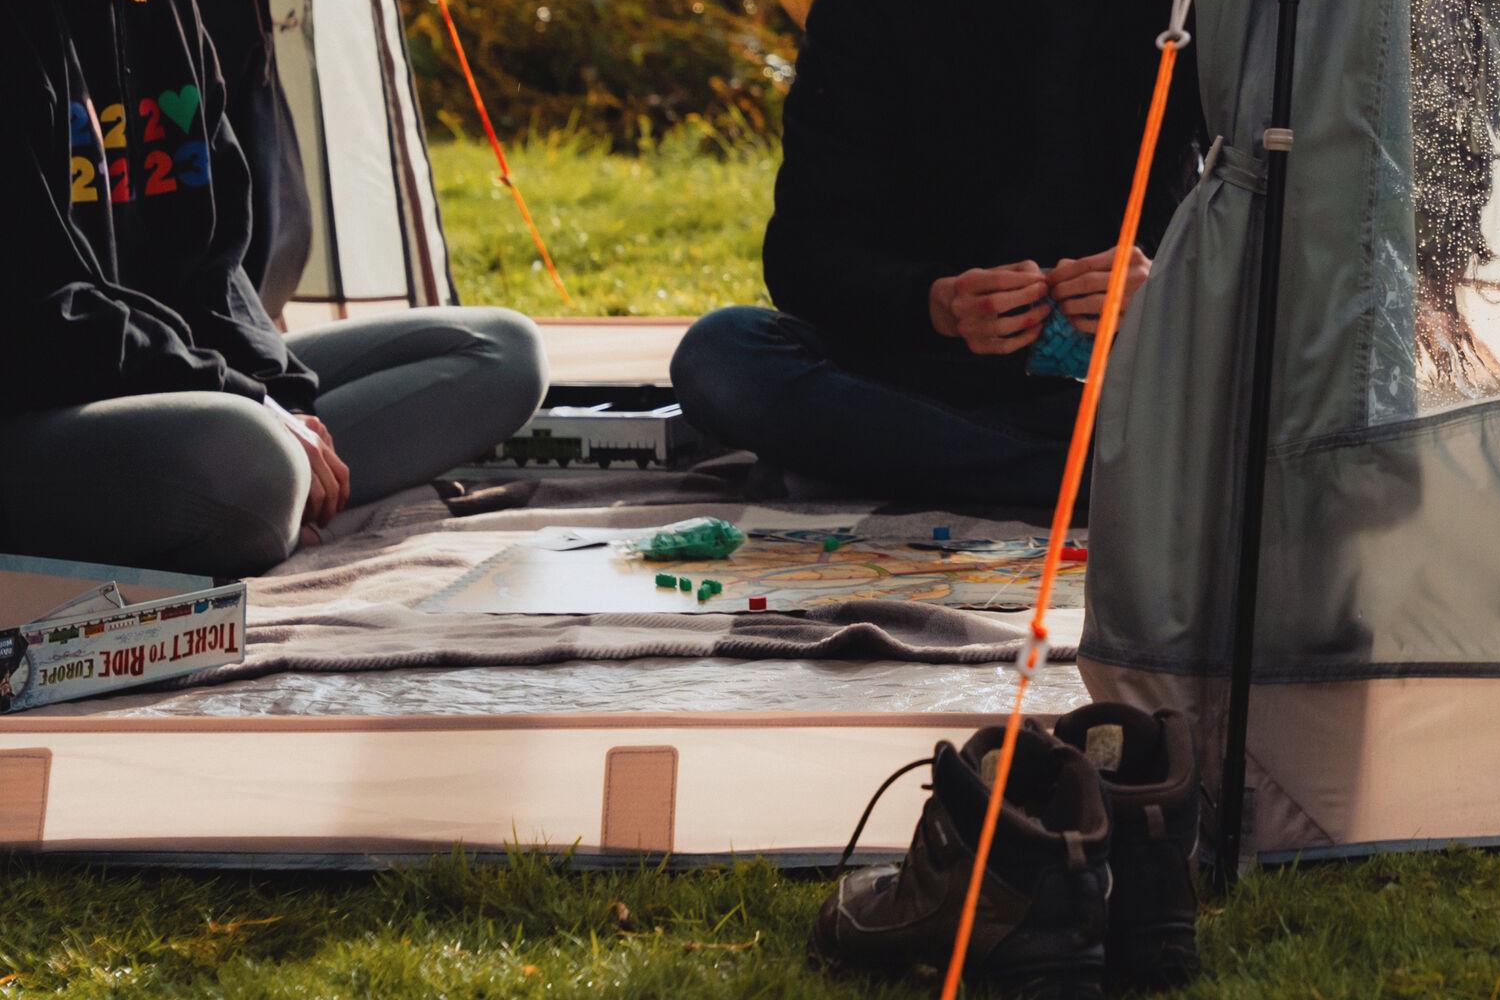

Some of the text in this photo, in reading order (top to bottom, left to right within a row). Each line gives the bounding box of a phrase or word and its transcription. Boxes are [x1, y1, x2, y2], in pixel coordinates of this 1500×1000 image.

[150, 642, 167, 663] TO
[169, 622, 238, 662] TICKET
[39, 658, 94, 686] EUROPE
[98, 645, 145, 677] RIDE
